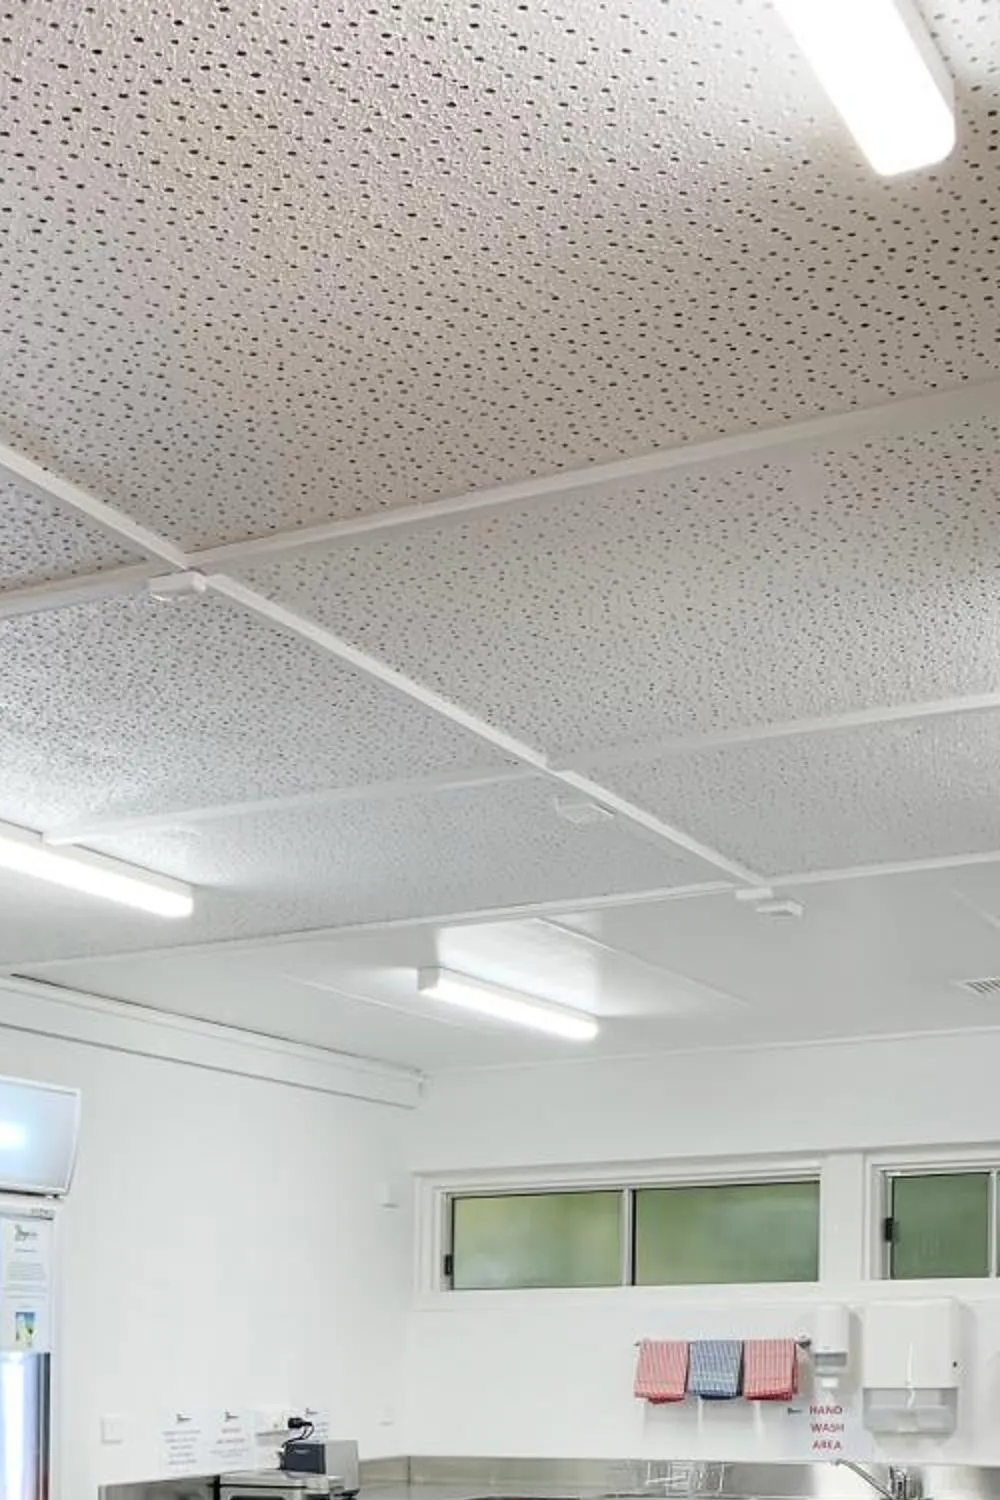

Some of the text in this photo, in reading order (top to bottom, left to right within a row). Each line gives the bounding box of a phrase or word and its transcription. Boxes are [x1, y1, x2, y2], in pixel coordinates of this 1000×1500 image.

[809, 1405, 843, 1415] HAND
[809, 1423, 845, 1433] WASH
[812, 1439, 843, 1450] AREA
